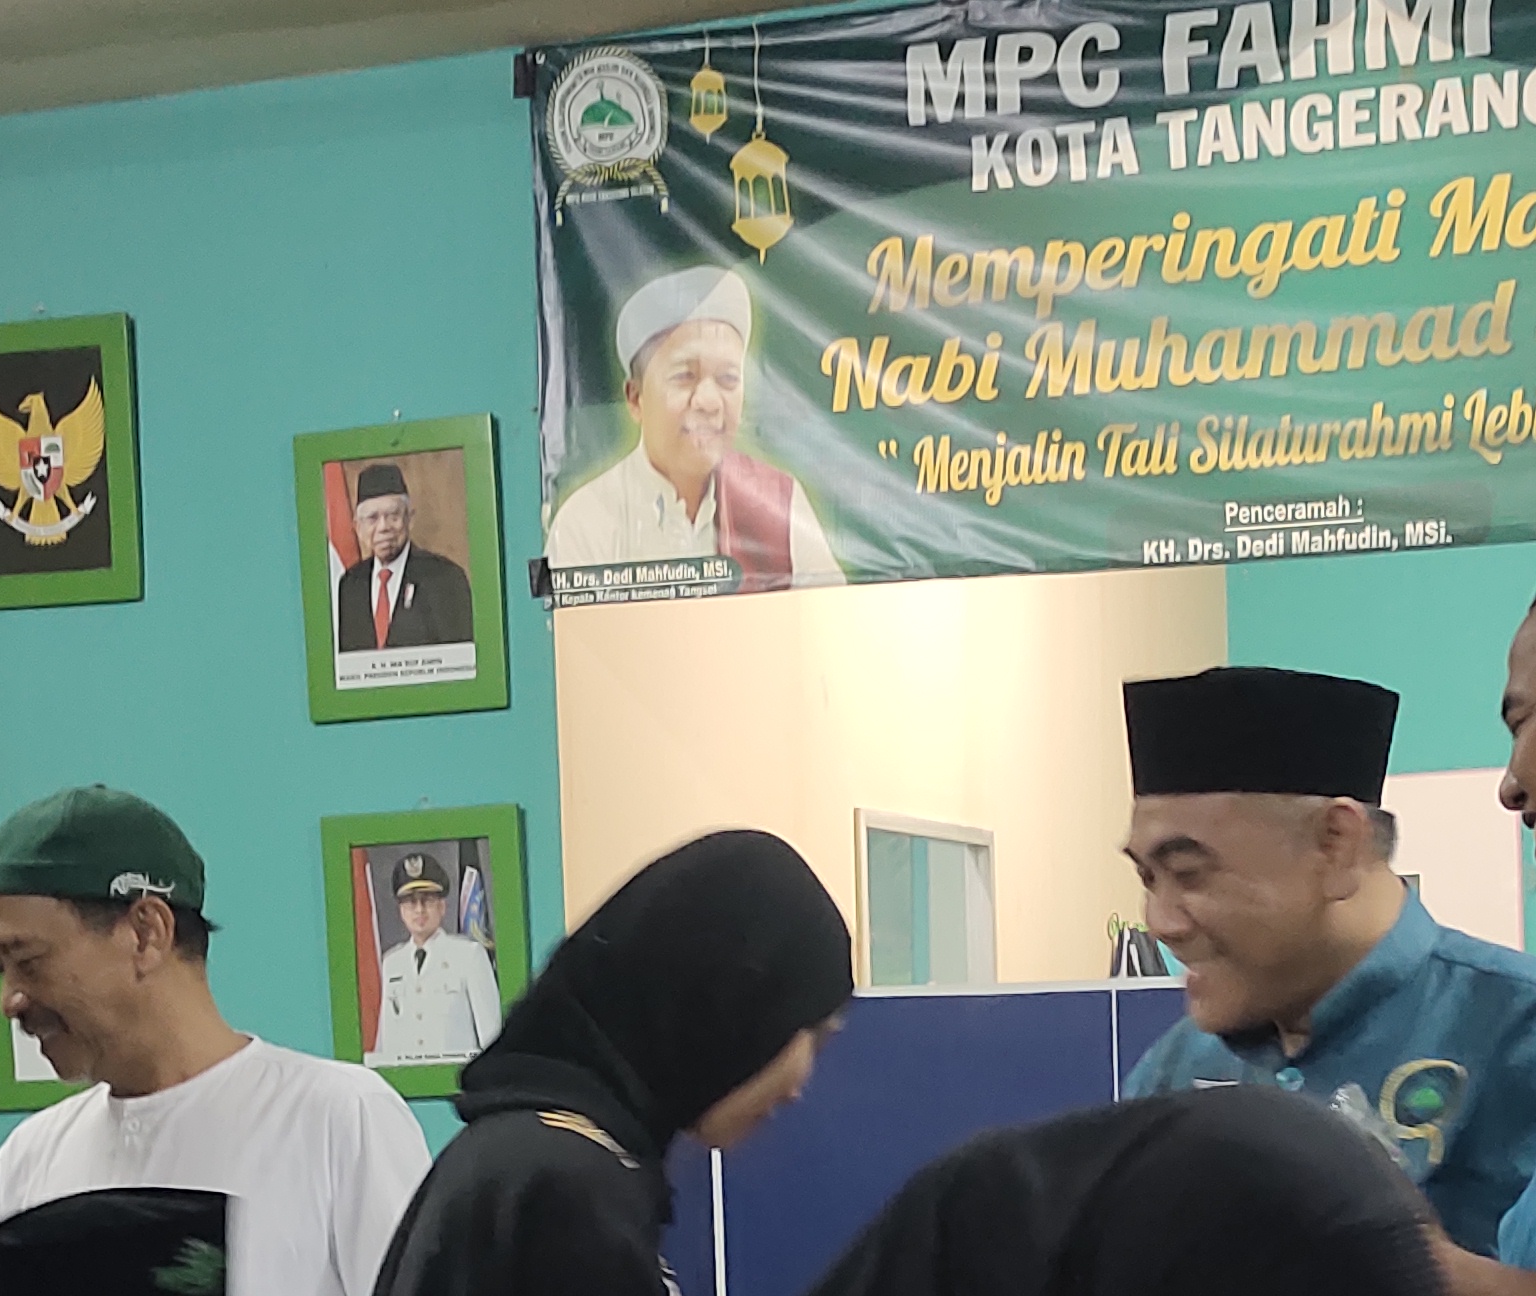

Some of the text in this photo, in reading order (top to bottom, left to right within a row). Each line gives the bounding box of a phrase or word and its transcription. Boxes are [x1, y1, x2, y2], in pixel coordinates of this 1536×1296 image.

[905, 22, 1121, 126] MPC
[1162, 0, 1492, 95] FAHMI
[970, 116, 1140, 192] KOTA
[866, 187, 1407, 319] Memperingati
[820, 331, 1004, 413] Nabi
[1024, 279, 1517, 399] Muhammad
[913, 428, 1087, 507] Menjalin
[1096, 421, 1180, 479] Tali
[1189, 394, 1455, 475] Silaturahmi
[1142, 519, 1453, 565] KH. Drs. Dedi Mahfudin, MSi.
[1225, 494, 1351, 526] Penceramah
[573, 570, 600, 588] Drs.
[603, 566, 633, 586] Dedi
